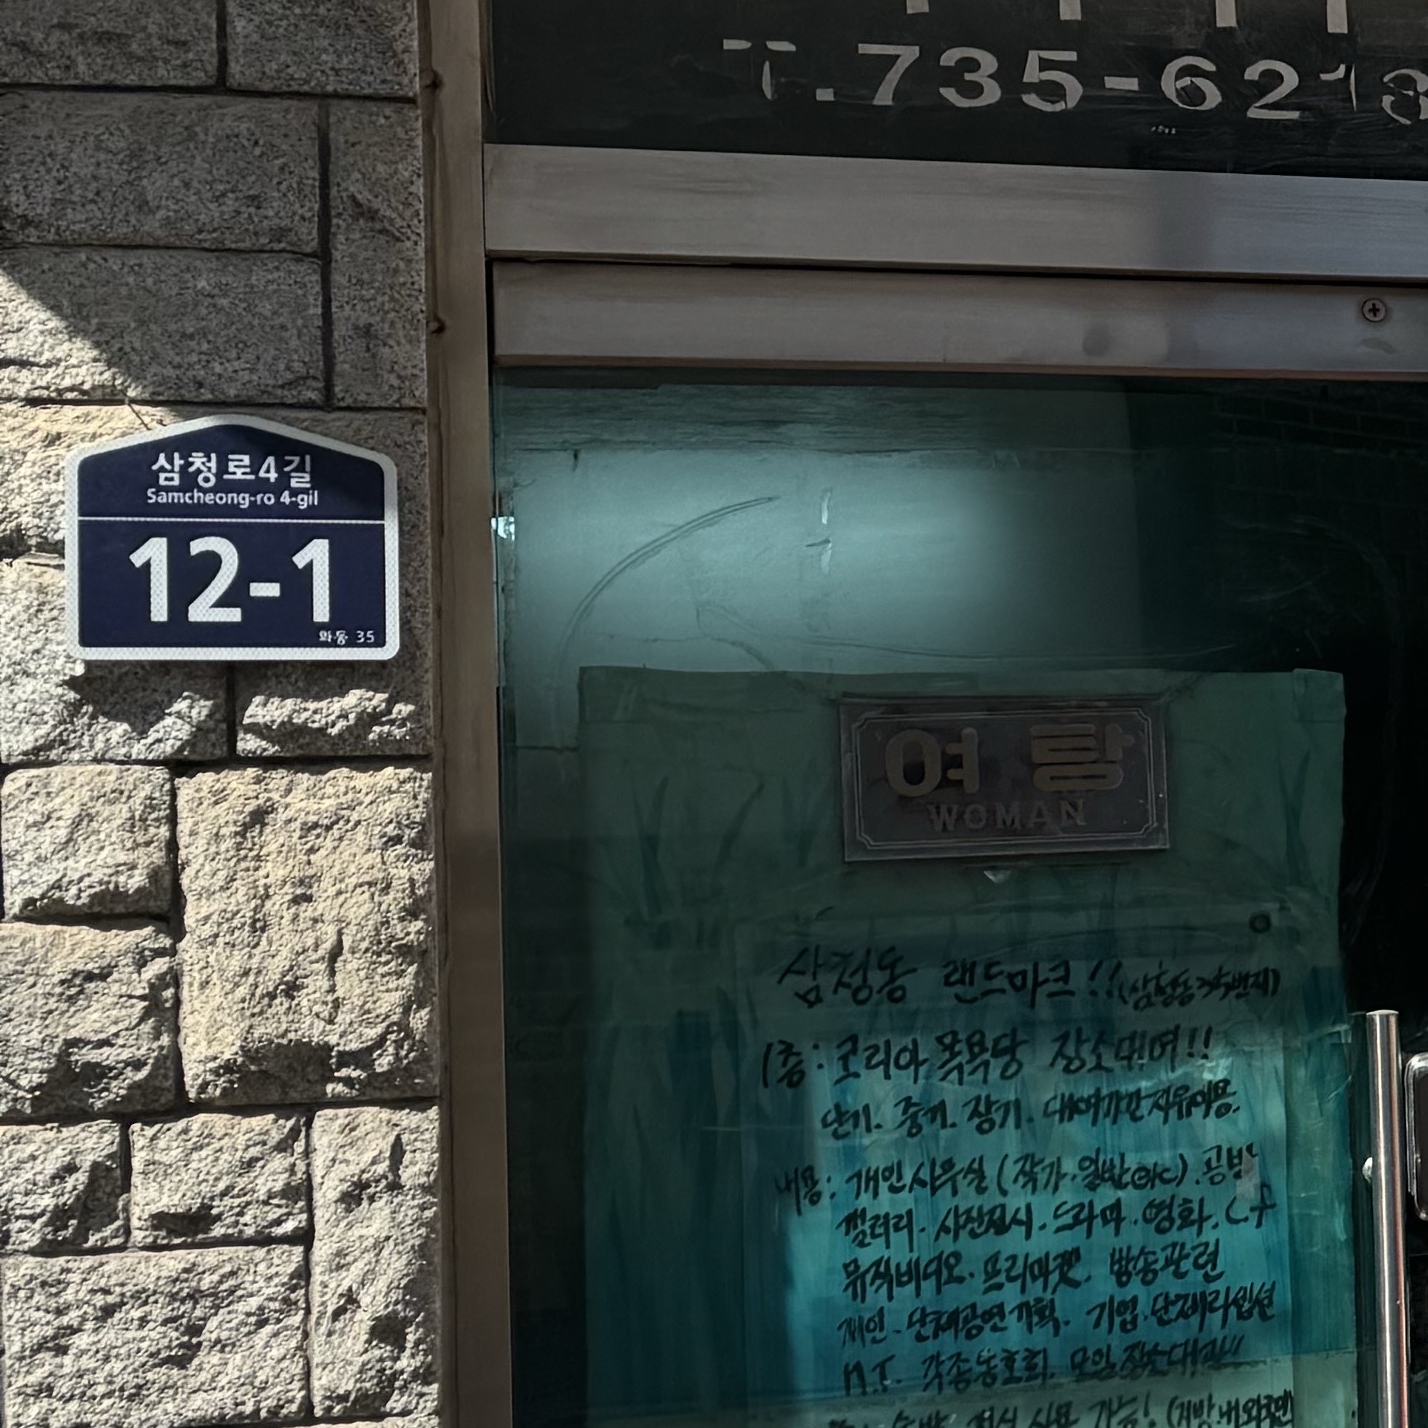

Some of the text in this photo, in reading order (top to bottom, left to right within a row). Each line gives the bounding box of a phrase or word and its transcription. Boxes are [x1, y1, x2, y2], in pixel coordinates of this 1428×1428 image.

[151, 452, 312, 489] 삼청로4길
[146, 488, 319, 509] Samcheong-ro 4-gil
[128, 536, 330, 623] 12-1
[356, 631, 375, 644] 35
[928, 798, 1088, 832] WOMAN
[833, 1033, 929, 1086] 코리아
